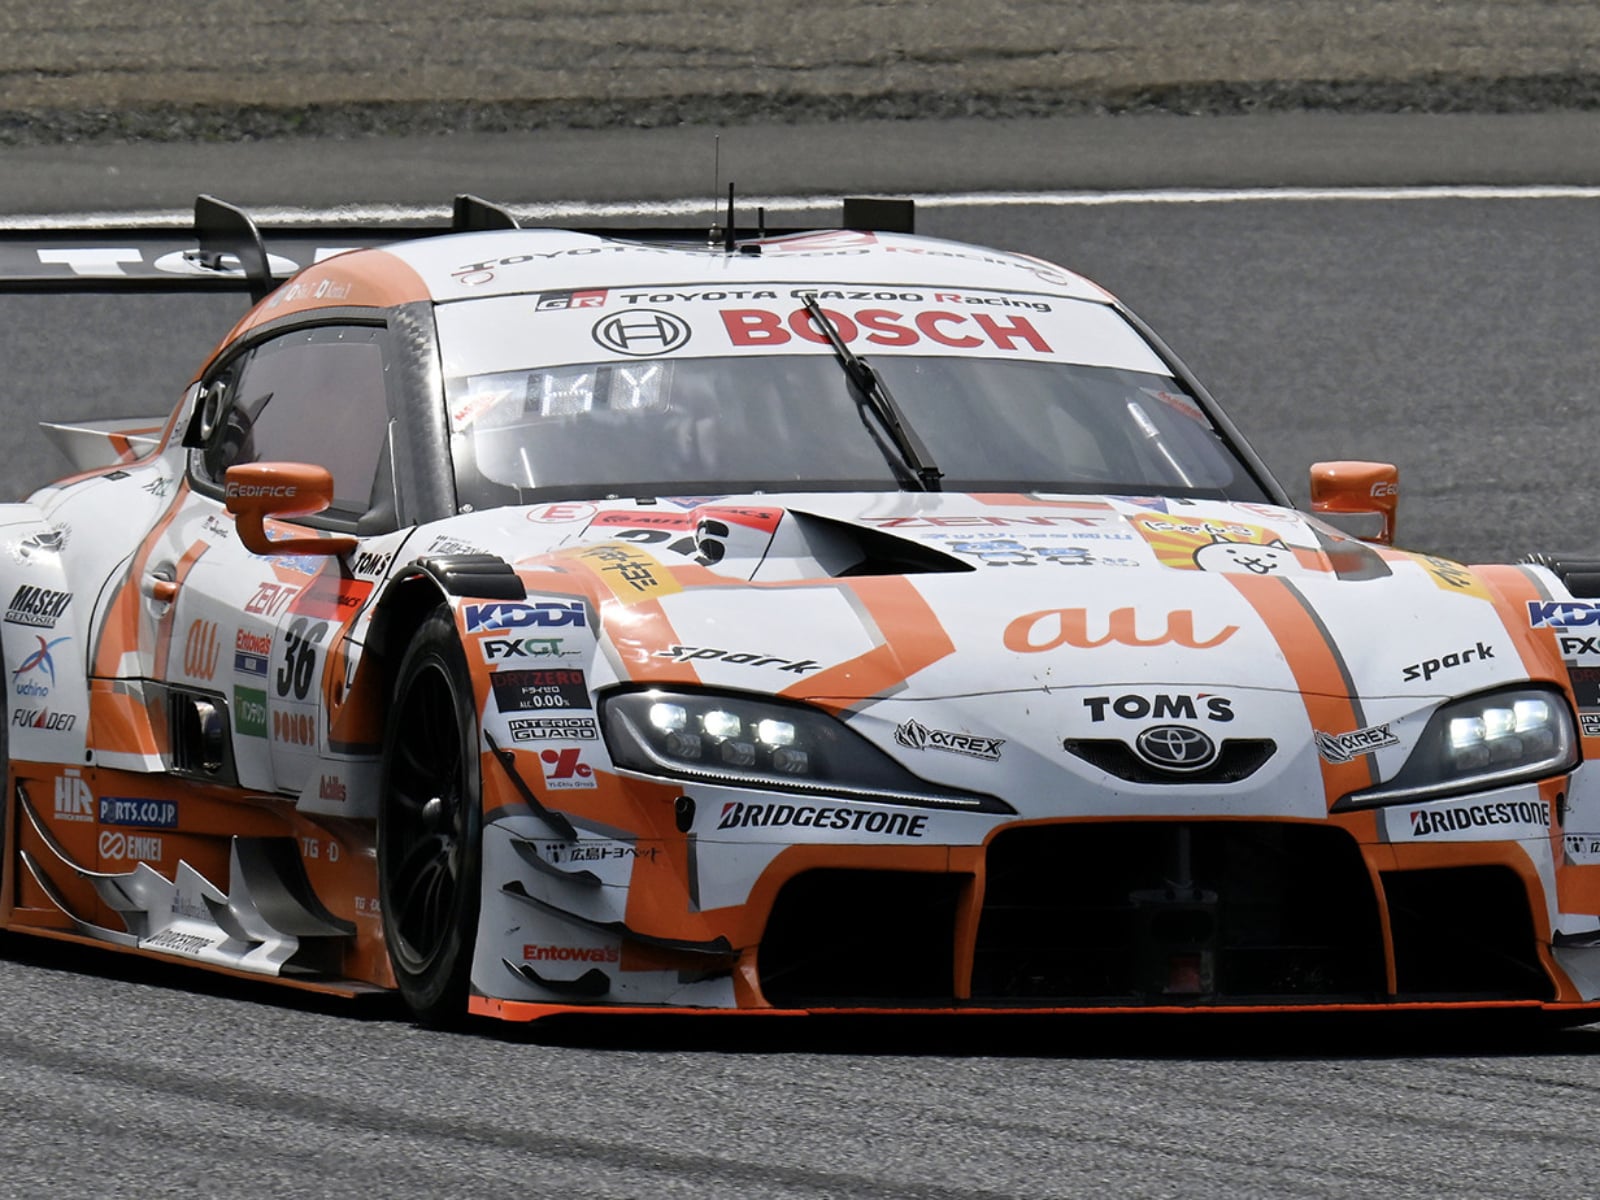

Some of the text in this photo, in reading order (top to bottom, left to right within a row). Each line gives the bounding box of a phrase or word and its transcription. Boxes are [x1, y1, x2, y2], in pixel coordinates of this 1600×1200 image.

[620, 290, 777, 304] TOYOTA
[791, 289, 924, 303] GAZOO
[935, 292, 1053, 313] Racing
[719, 308, 1055, 354] BOSCH
[238, 485, 297, 497] EDIFICE
[859, 516, 1106, 528] ZENT
[352, 551, 393, 576] TOM'S
[8, 584, 74, 619] MASEKI
[244, 581, 302, 617] ZENT
[465, 602, 586, 632] KDDI
[1003, 606, 1240, 653] au
[184, 618, 221, 682] au
[277, 617, 329, 700] 36
[658, 646, 823, 674] spark
[1402, 642, 1495, 682] spark
[16, 678, 49, 698] uchino
[1083, 693, 1235, 723] TOM'S
[511, 719, 594, 729] INTERIOR
[514, 728, 596, 739] GUARD
[717, 802, 929, 837] BRIDGESTONE
[1410, 802, 1550, 837] BRIDGESTONE
[127, 836, 162, 861] ENKEI
[570, 847, 662, 863] 広島トヨペット
[523, 944, 619, 963] Entowa's
